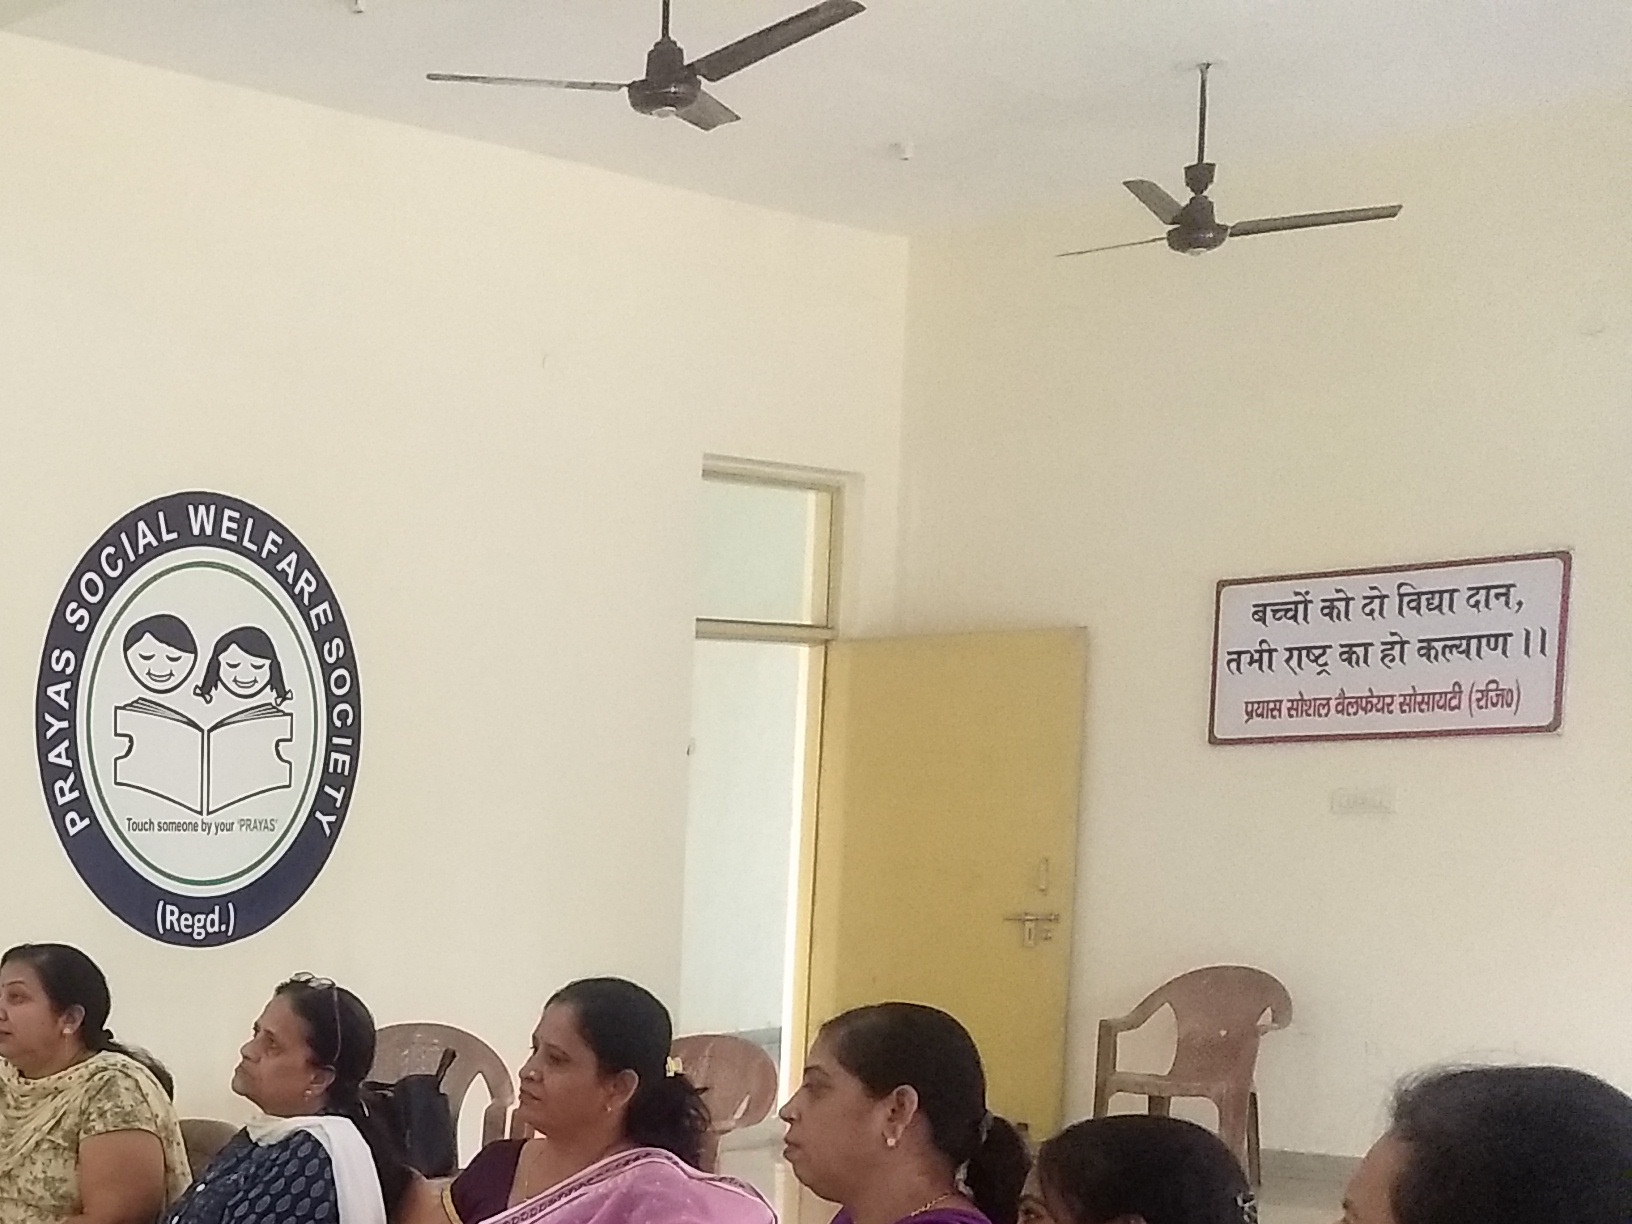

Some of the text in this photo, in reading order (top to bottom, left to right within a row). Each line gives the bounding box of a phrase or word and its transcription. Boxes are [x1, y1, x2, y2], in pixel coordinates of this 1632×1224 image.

[1251, 582, 1524, 627] बच्चों को दो विद्या दान,
[44, 504, 355, 837] PRAYAS SOCIAL WELFARE SOCIETY
[1226, 639, 1279, 675] तभी
[1283, 644, 1334, 676] राष्ट्र
[1338, 642, 1375, 668] का
[1380, 631, 1411, 669] हो
[1416, 632, 1514, 663] कल्याण
[1244, 699, 1284, 724] प्रयास
[1286, 690, 1333, 718] सोशल
[1399, 681, 1464, 714] सोसायटी
[126, 817, 155, 832] Touch
[157, 821, 199, 832] someone
[201, 818, 213, 835] by
[214, 821, 235, 835] your
[156, 900, 235, 940] (Regd.)
